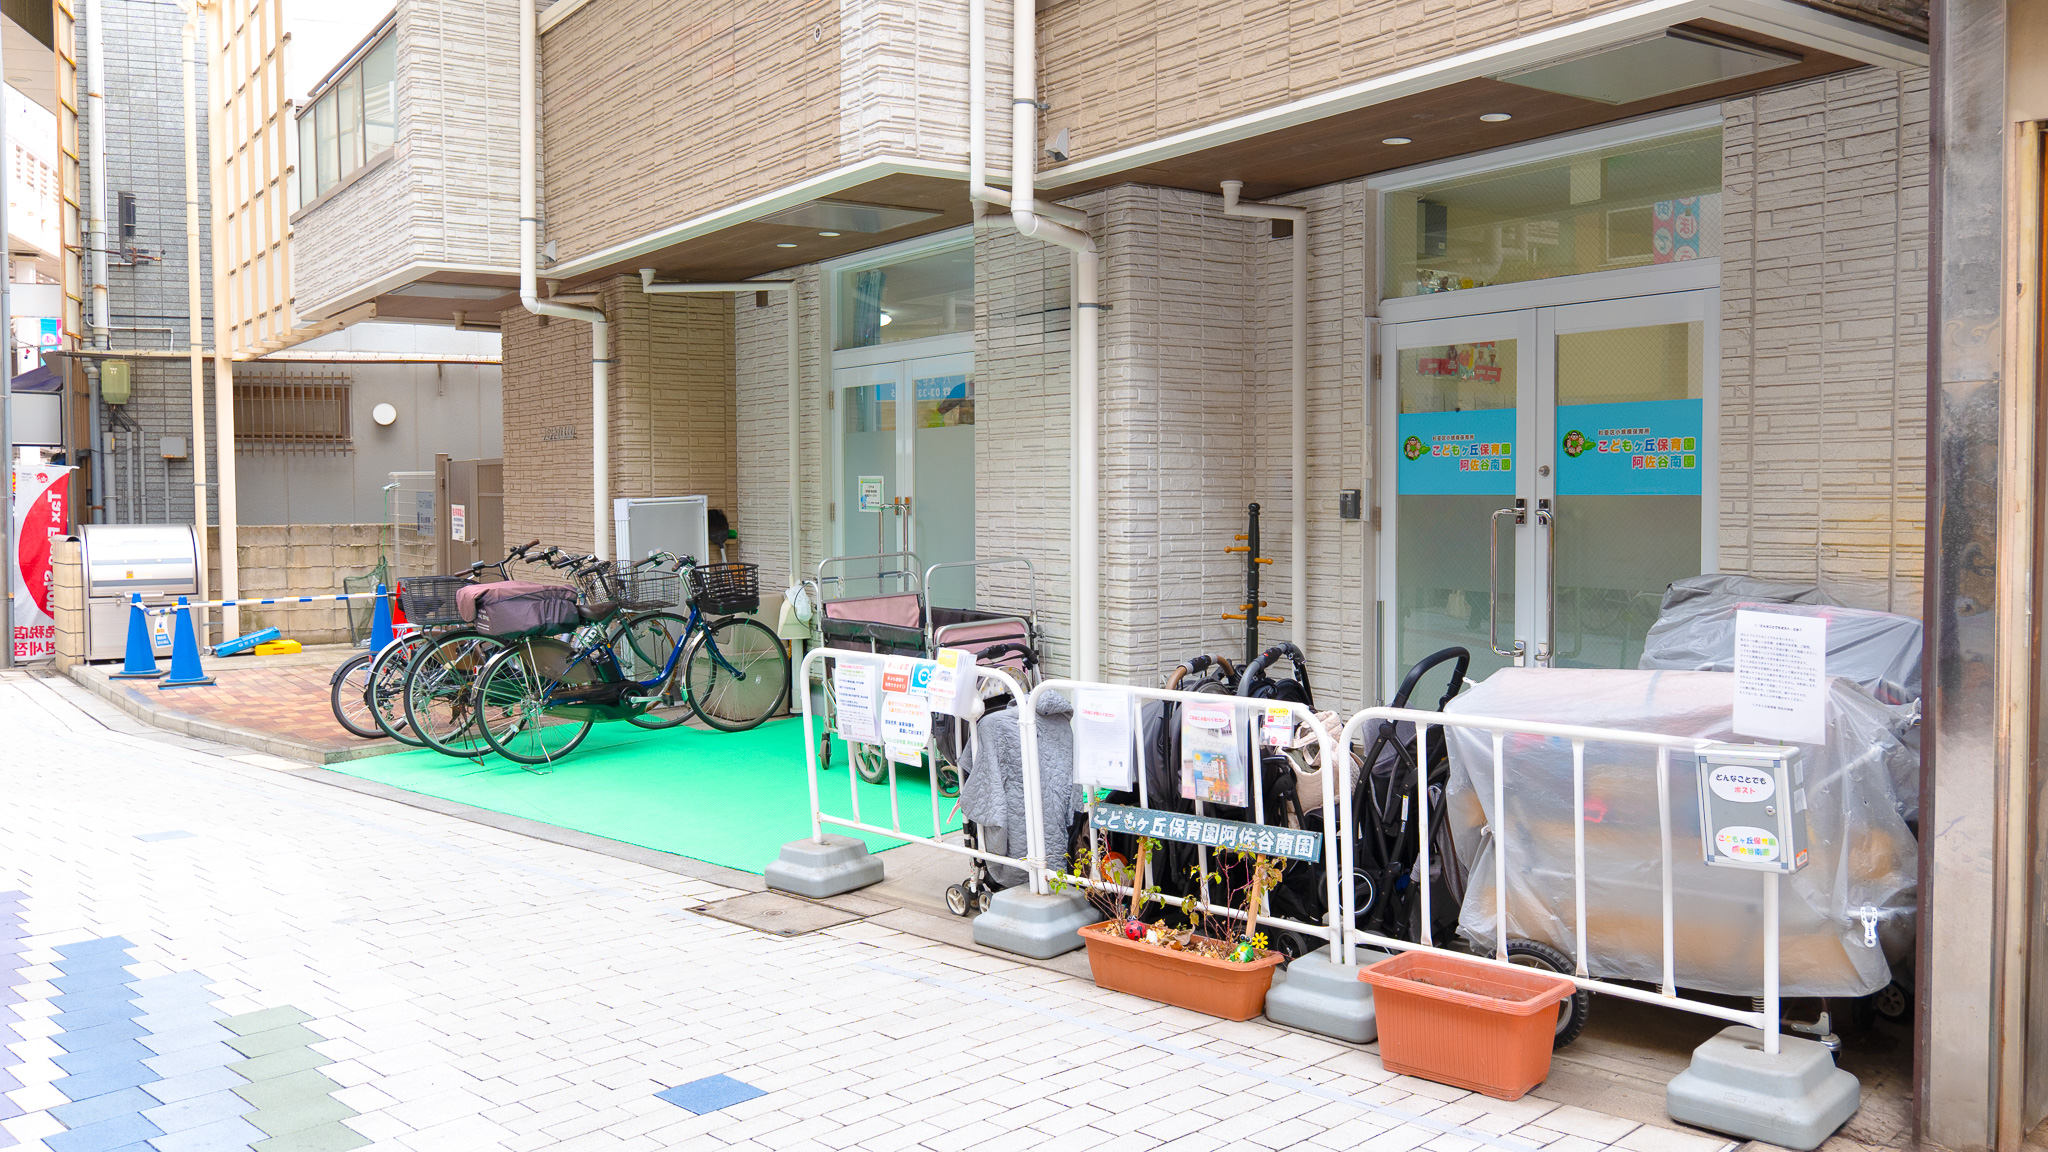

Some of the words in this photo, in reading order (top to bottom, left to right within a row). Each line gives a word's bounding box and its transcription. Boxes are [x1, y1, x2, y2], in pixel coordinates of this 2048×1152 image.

[1459, 458, 1511, 472] 阿佐谷南園
[1631, 454, 1696, 470] 阿佐谷南園
[1715, 773, 1767, 785] どんなことでも
[1734, 786, 1756, 795] ポスト
